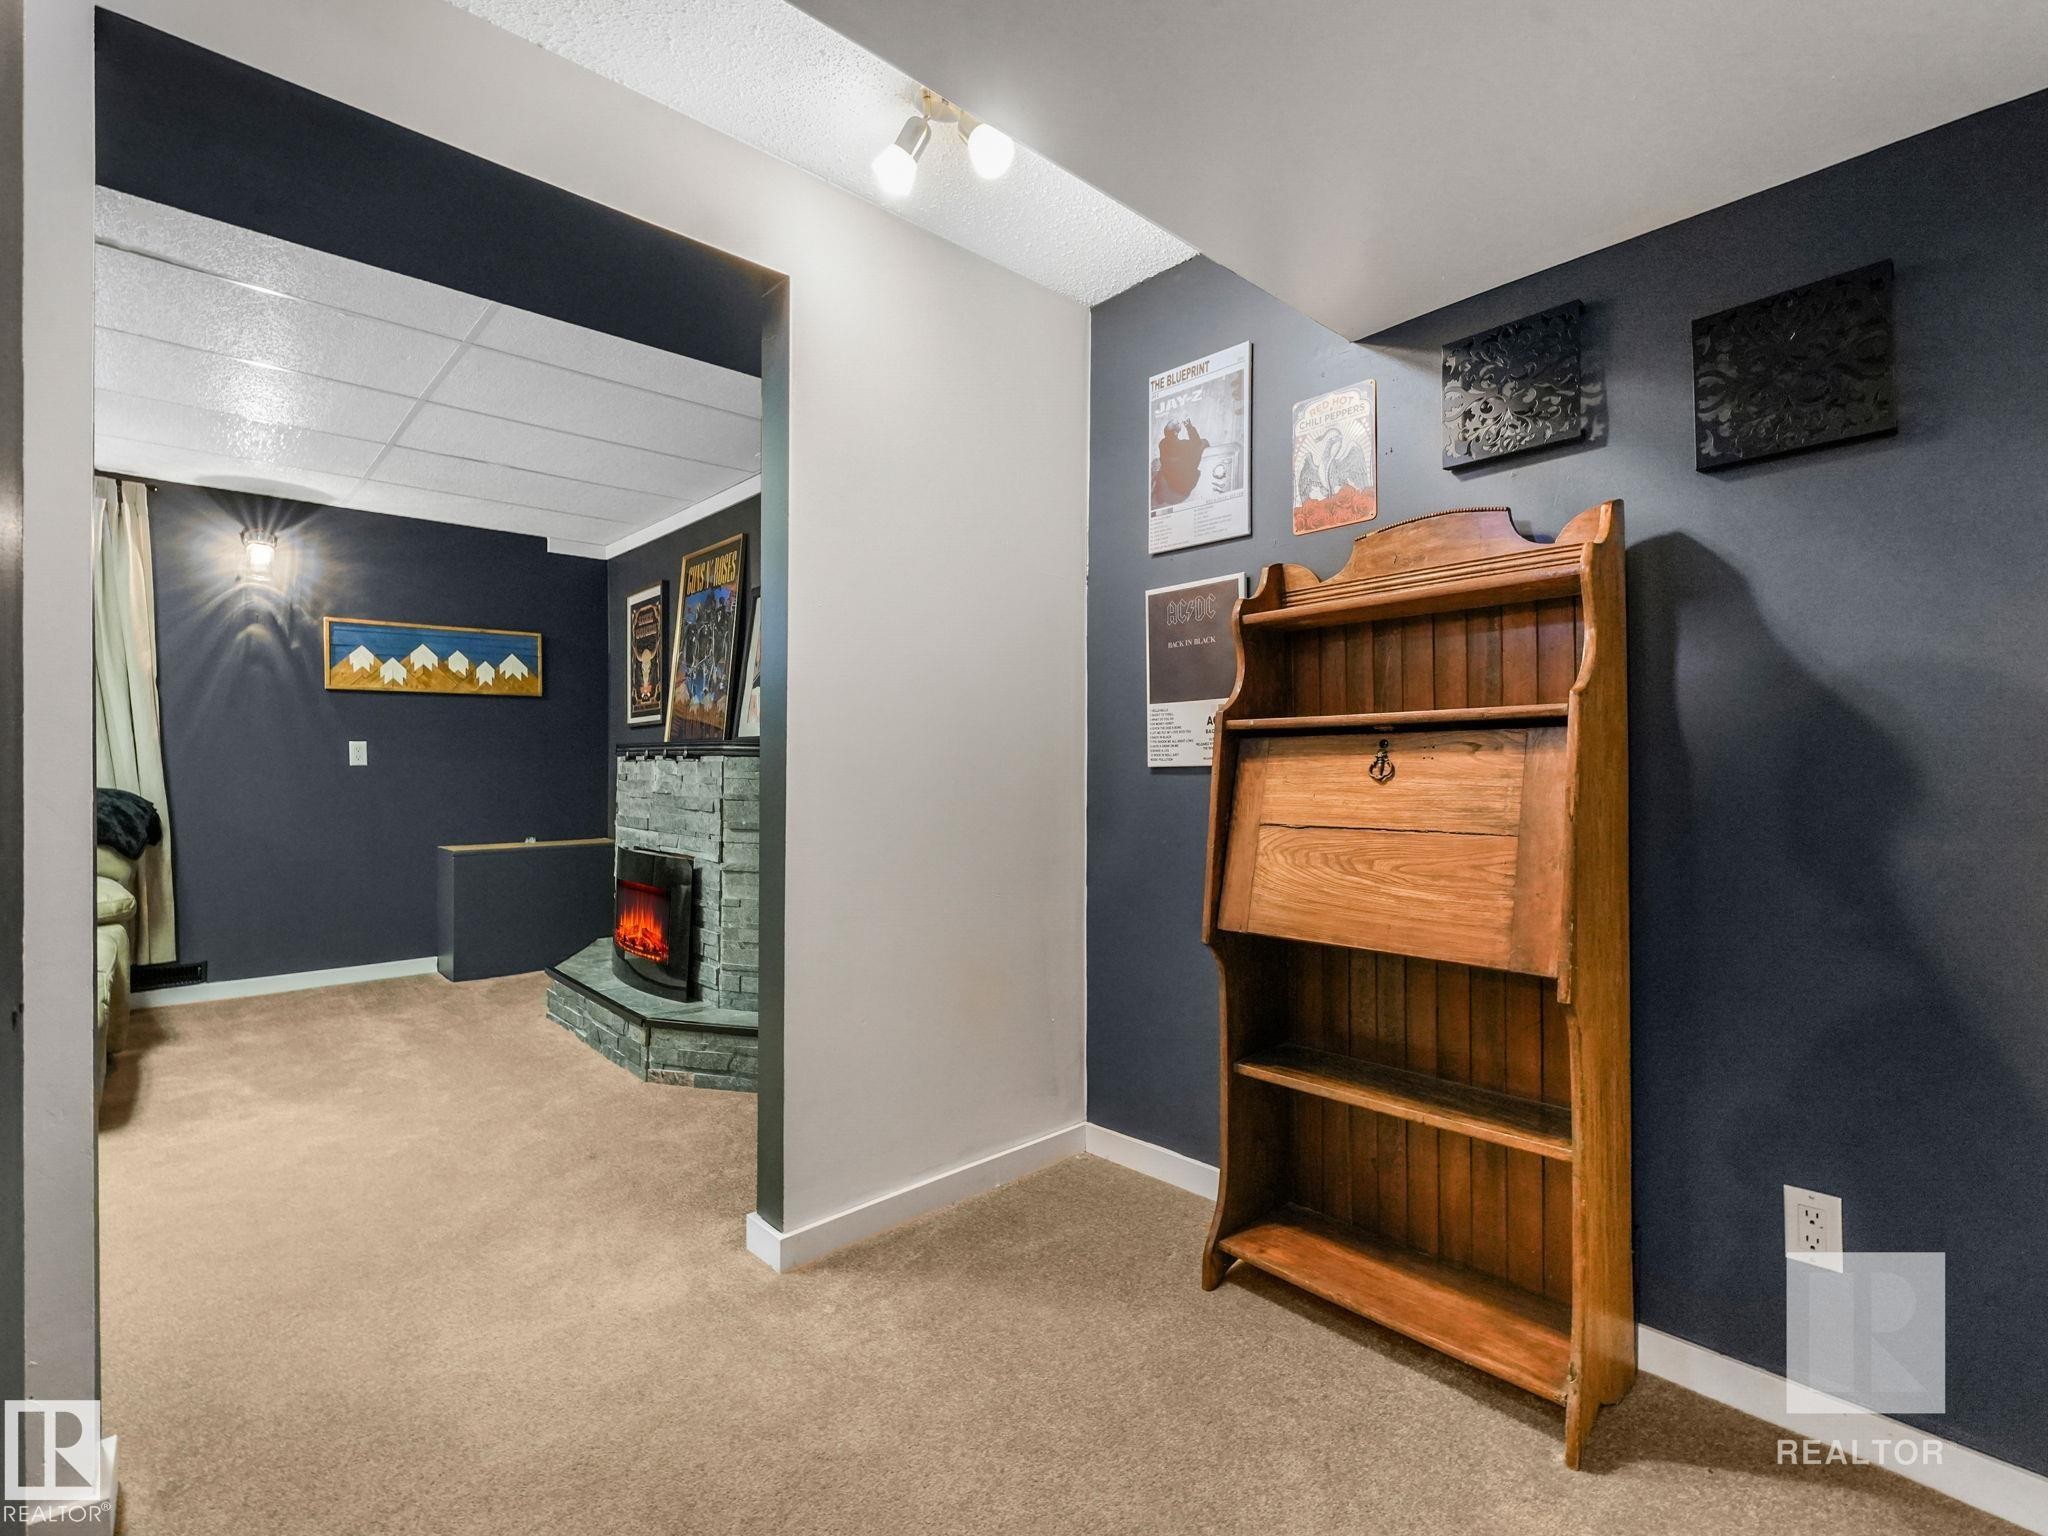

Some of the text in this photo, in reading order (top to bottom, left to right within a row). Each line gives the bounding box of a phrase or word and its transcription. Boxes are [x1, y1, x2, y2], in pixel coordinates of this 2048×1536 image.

[1150, 360, 1210, 392] THE BLUEPRINT
[1154, 388, 1203, 415] JAY-Z
[1309, 395, 1354, 418] RED HOT
[1299, 402, 1365, 430] CHILI PEPPERS
[686, 561, 706, 596] GUNS
[713, 550, 738, 588] ROSES
[1167, 639, 1184, 649] BACK
[1193, 635, 1217, 646] BLACK
